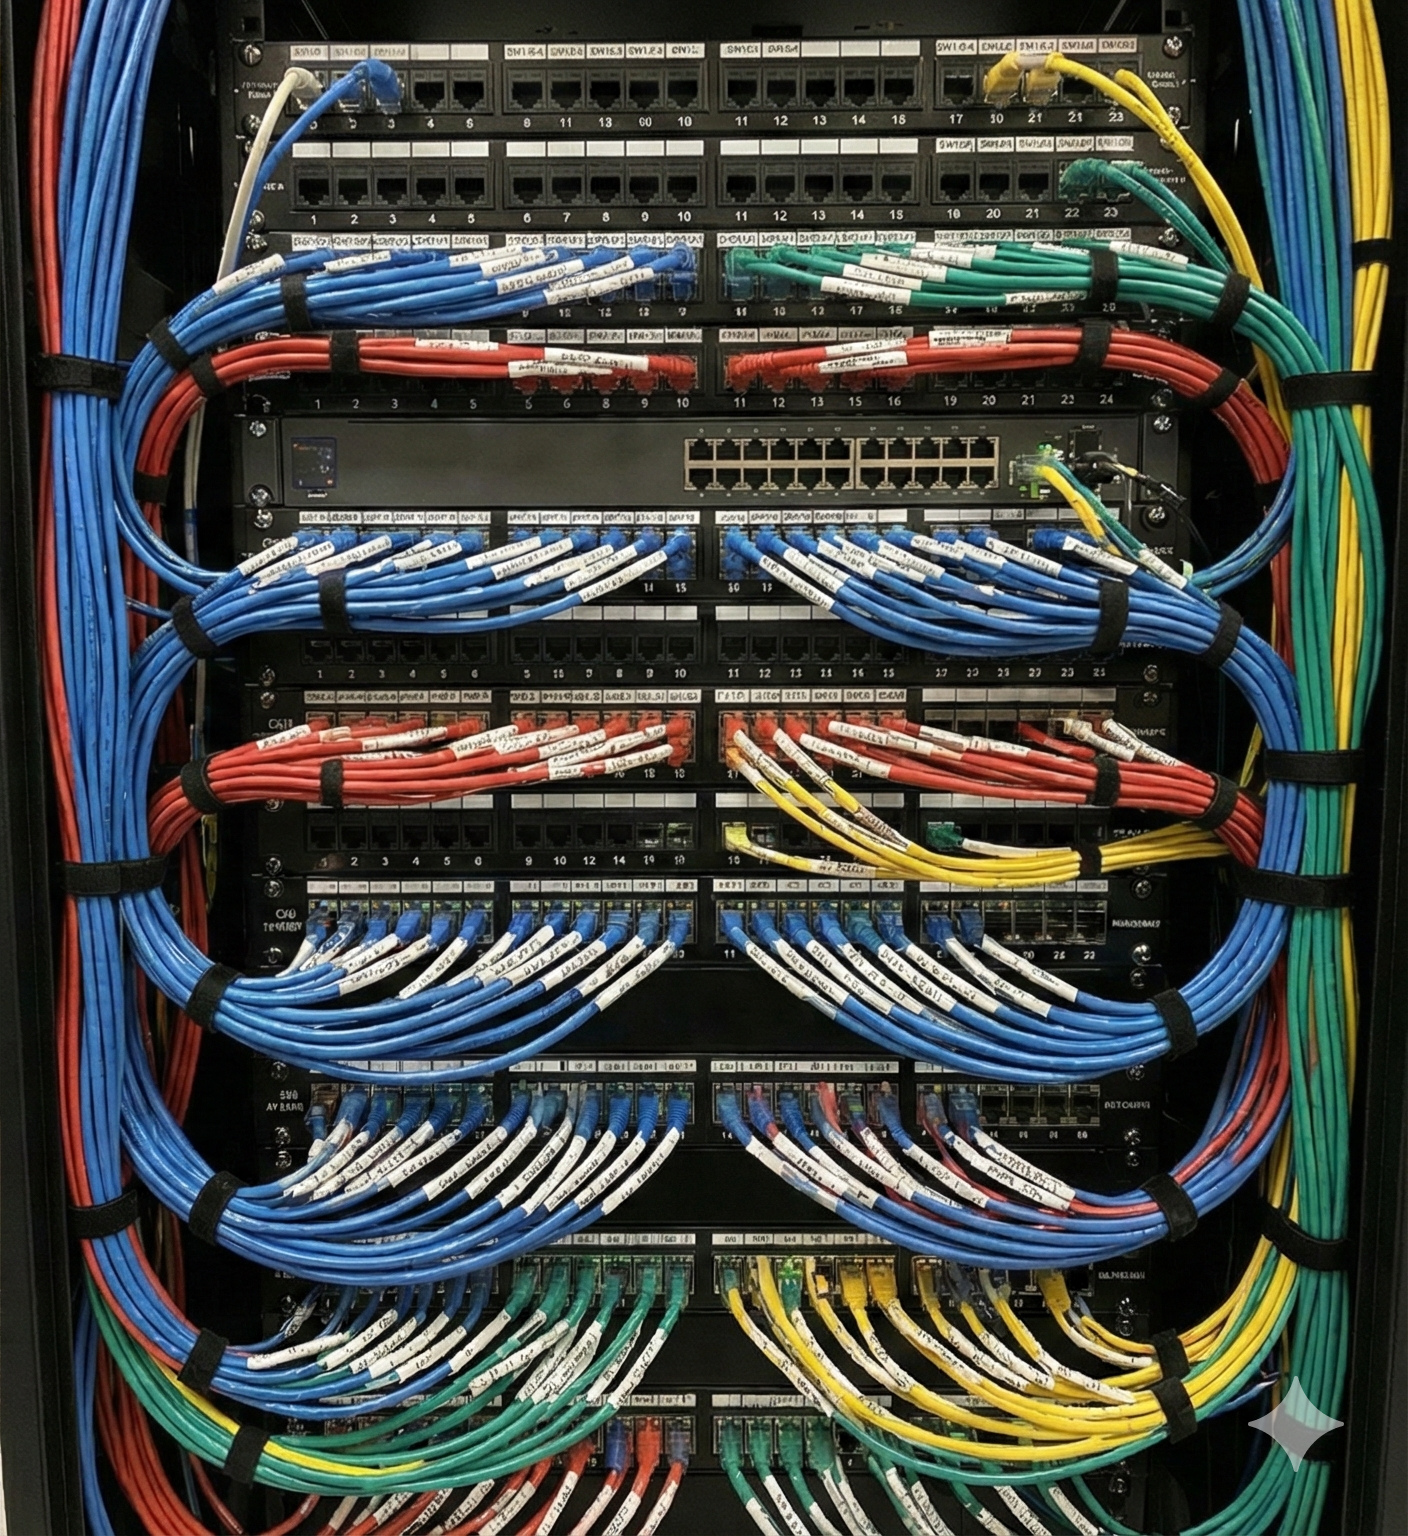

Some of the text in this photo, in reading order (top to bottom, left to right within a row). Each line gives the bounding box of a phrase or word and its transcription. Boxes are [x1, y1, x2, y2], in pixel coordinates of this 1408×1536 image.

[560, 117, 571, 127] 11
[599, 117, 612, 127] 13
[735, 116, 747, 126] 11
[774, 115, 788, 125] 12
[813, 115, 826, 125] 13
[852, 115, 865, 125] 14
[950, 114, 963, 124] 17
[1028, 112, 1042, 123] 21
[1109, 112, 1123, 122] 23
[524, 213, 531, 223] 6
[563, 212, 570, 222] 7
[678, 211, 691, 222] 10
[736, 211, 747, 221] 11
[774, 210, 787, 221] 12
[812, 210, 825, 220] 13
[851, 210, 864, 220] 14
[986, 208, 1000, 218] 20
[1026, 208, 1038, 218] 21
[1065, 208, 1079, 218] 22
[312, 215, 316, 224] 1
[351, 214, 358, 224] 2
[390, 214, 396, 224] 3
[429, 214, 435, 223] 4
[315, 399, 320, 409] 1
[353, 399, 359, 409] 2
[392, 399, 398, 409] 3
[564, 398, 570, 408] 6
[603, 398, 610, 408] 8
[641, 398, 648, 408] 9
[677, 398, 689, 408] 10
[734, 396, 901, 407] 11 12 13 15 16
[945, 396, 957, 406] 19
[982, 395, 996, 405] 20
[1022, 395, 1034, 405] 21
[1100, 394, 1113, 404] 24
[318, 670, 322, 678] 1
[675, 669, 686, 678] 10
[760, 668, 771, 678] 12
[351, 857, 357, 866] 2
[383, 857, 388, 866] 3
[413, 857, 419, 865] 4
[444, 857, 450, 865] 5
[526, 856, 532, 865] 9
[554, 856, 566, 865] 10
[584, 856, 595, 865] 12
[614, 856, 625, 864] 14
